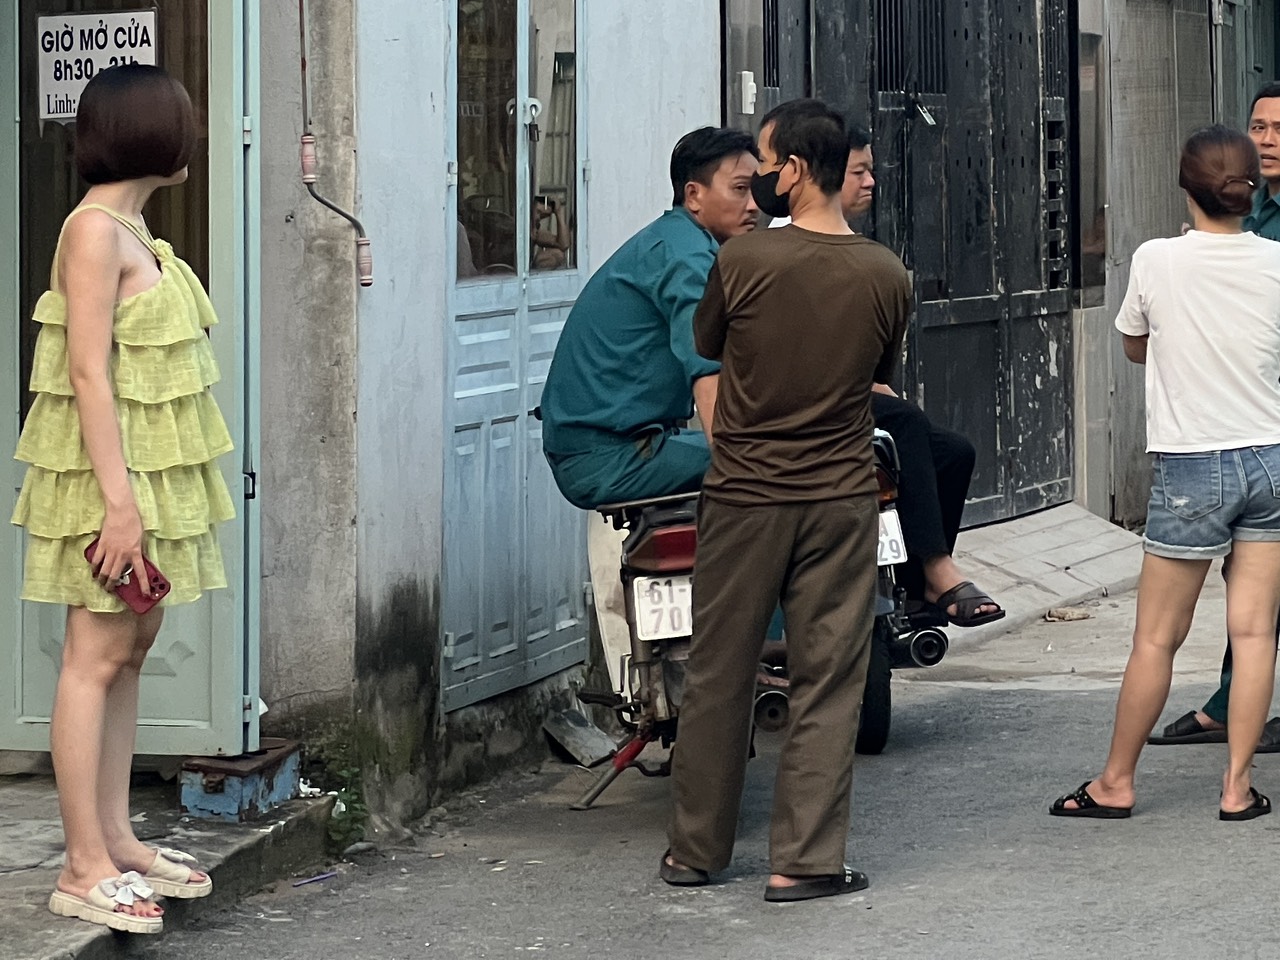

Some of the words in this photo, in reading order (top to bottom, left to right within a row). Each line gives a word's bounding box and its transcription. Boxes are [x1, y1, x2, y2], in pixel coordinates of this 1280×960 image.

[41, 23, 74, 53] GIỜ
[80, 20, 108, 50] MỞ
[114, 18, 151, 49] CỬA
[53, 58, 94, 81] 8h30
[47, 93, 76, 115] Linh:
[650, 576, 693, 605] 61-
[650, 606, 692, 634] 70
